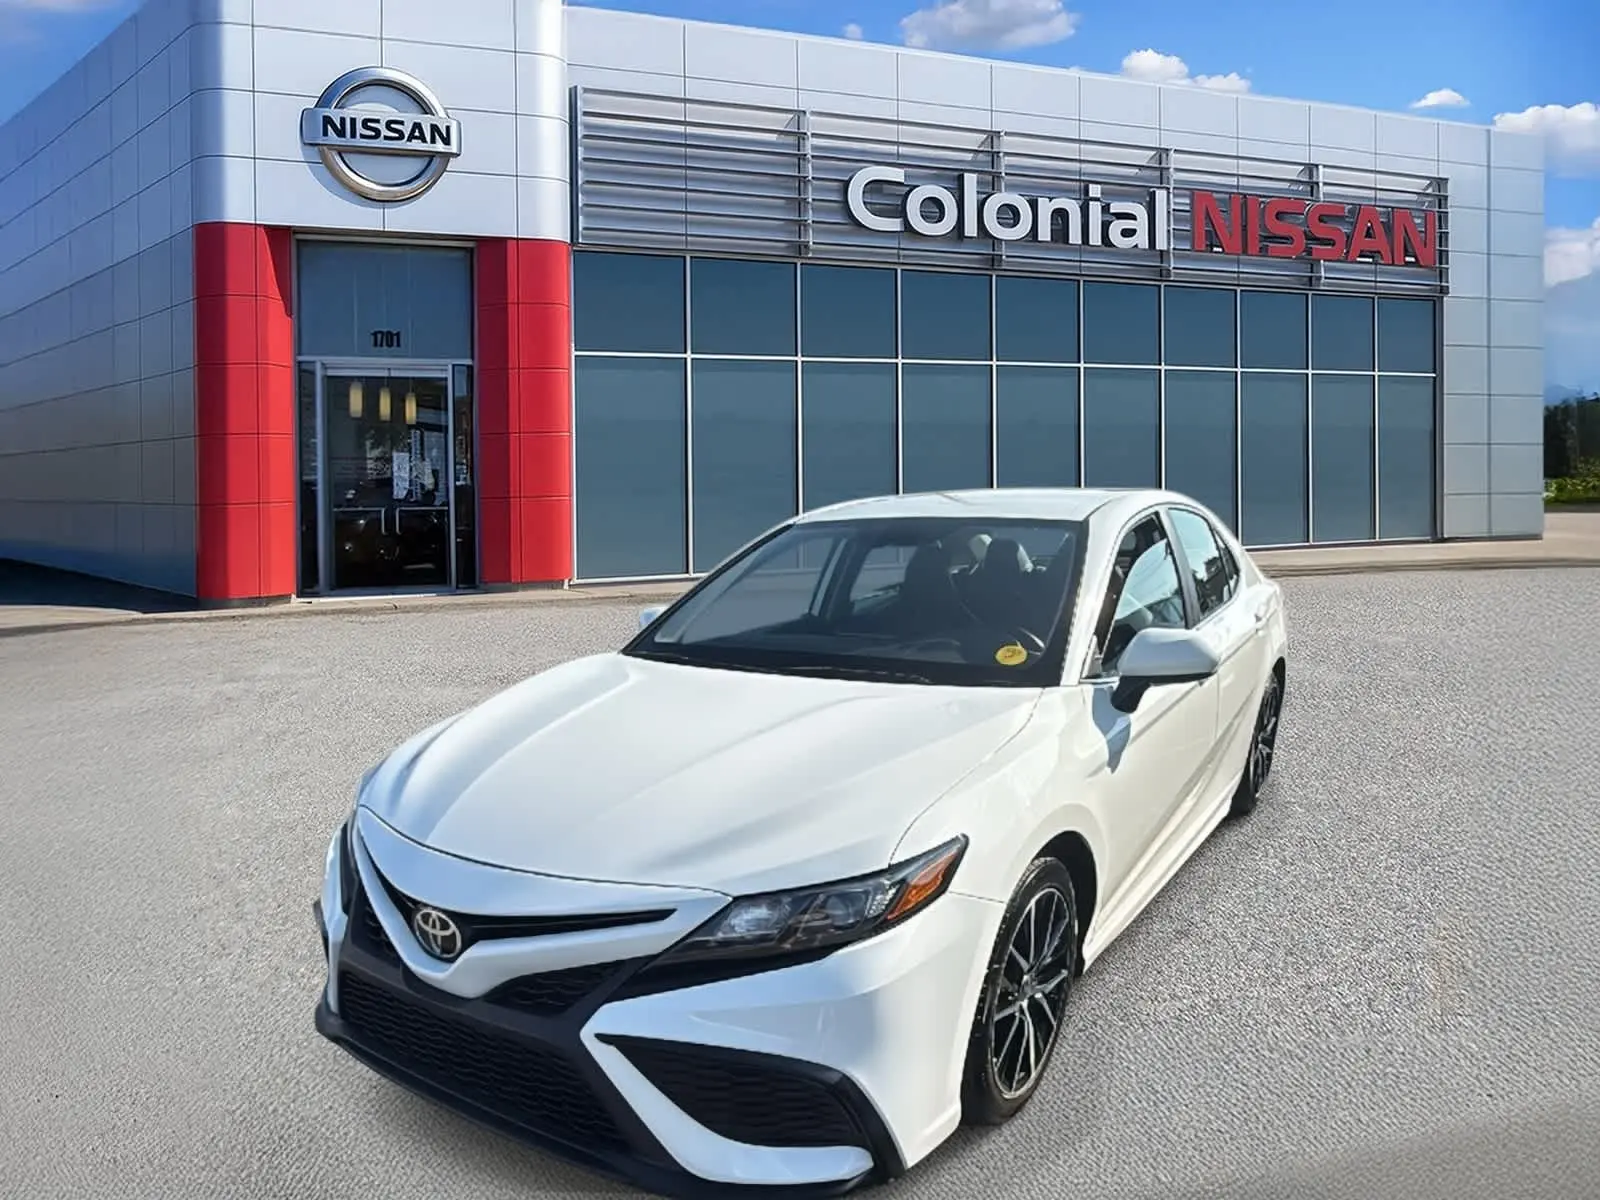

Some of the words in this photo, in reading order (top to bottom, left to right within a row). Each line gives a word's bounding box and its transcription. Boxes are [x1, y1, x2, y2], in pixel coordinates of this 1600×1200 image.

[322, 115, 451, 146] NISSAN
[846, 165, 1168, 251] Colonial
[1191, 189, 1436, 268] NISSAN
[370, 330, 402, 348] 1701
